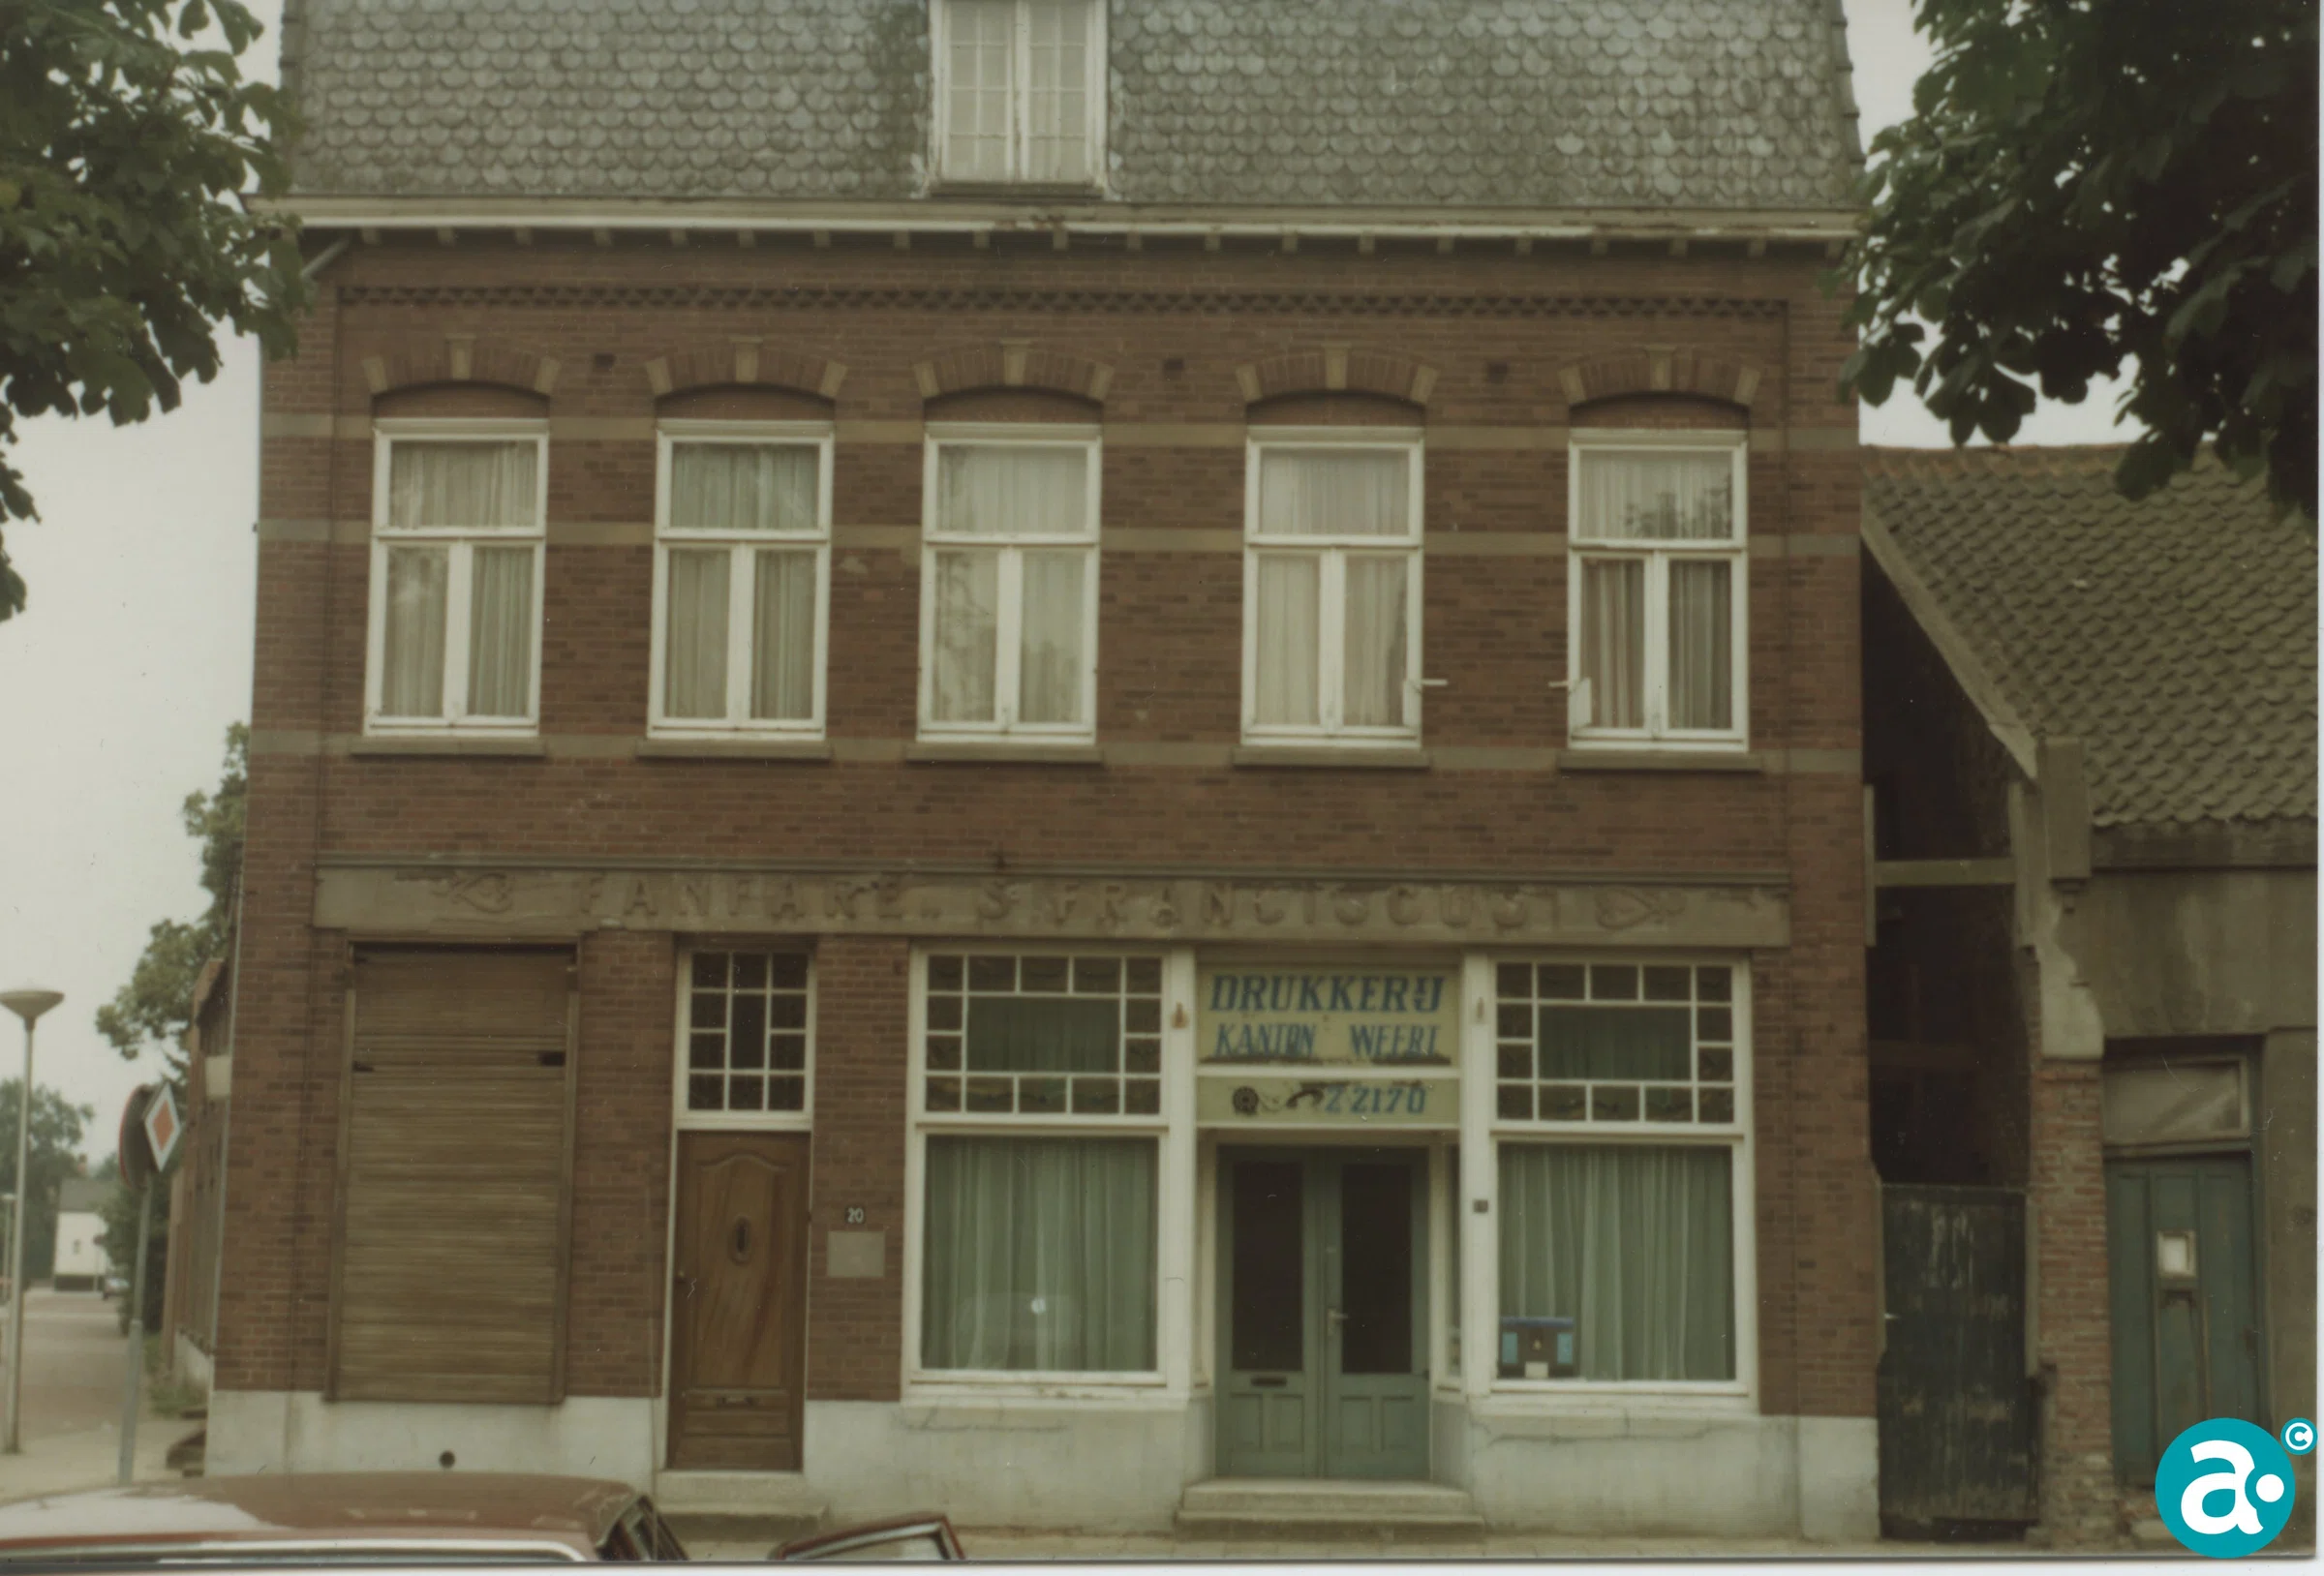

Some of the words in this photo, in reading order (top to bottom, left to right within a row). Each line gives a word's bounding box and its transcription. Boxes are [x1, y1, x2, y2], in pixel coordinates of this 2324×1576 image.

[1209, 974, 1447, 1013] DRUKKERIJ
[1213, 1022, 1318, 1057] KANTON
[1349, 1023, 1442, 1058] WEERT
[847, 1207, 865, 1224] 20
